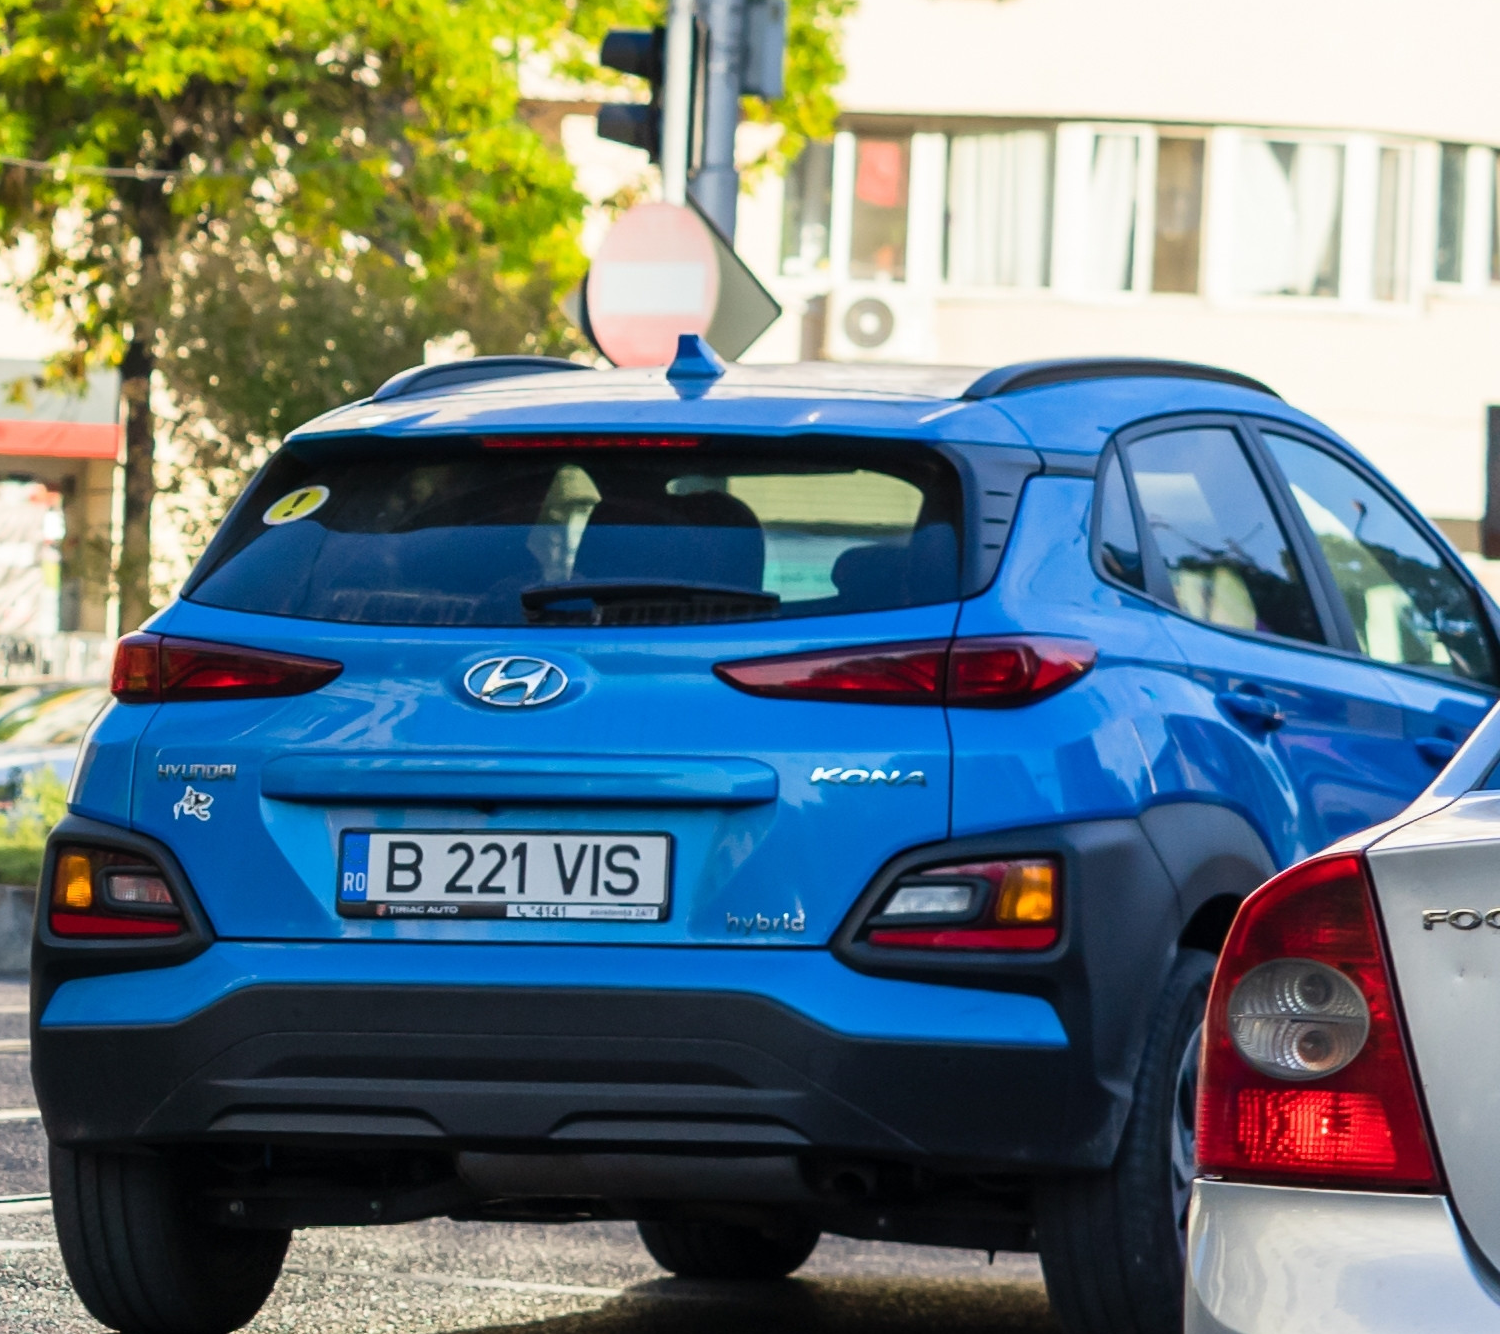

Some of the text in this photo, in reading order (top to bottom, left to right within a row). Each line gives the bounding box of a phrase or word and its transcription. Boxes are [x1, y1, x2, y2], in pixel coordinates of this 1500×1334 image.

[158, 763, 238, 780] HYUNDAI
[808, 766, 927, 787] KONA
[386, 841, 642, 897] B 221 VIS
[343, 872, 366, 892] RO
[426, 905, 459, 915] AUTO
[725, 911, 806, 937] hybrid
